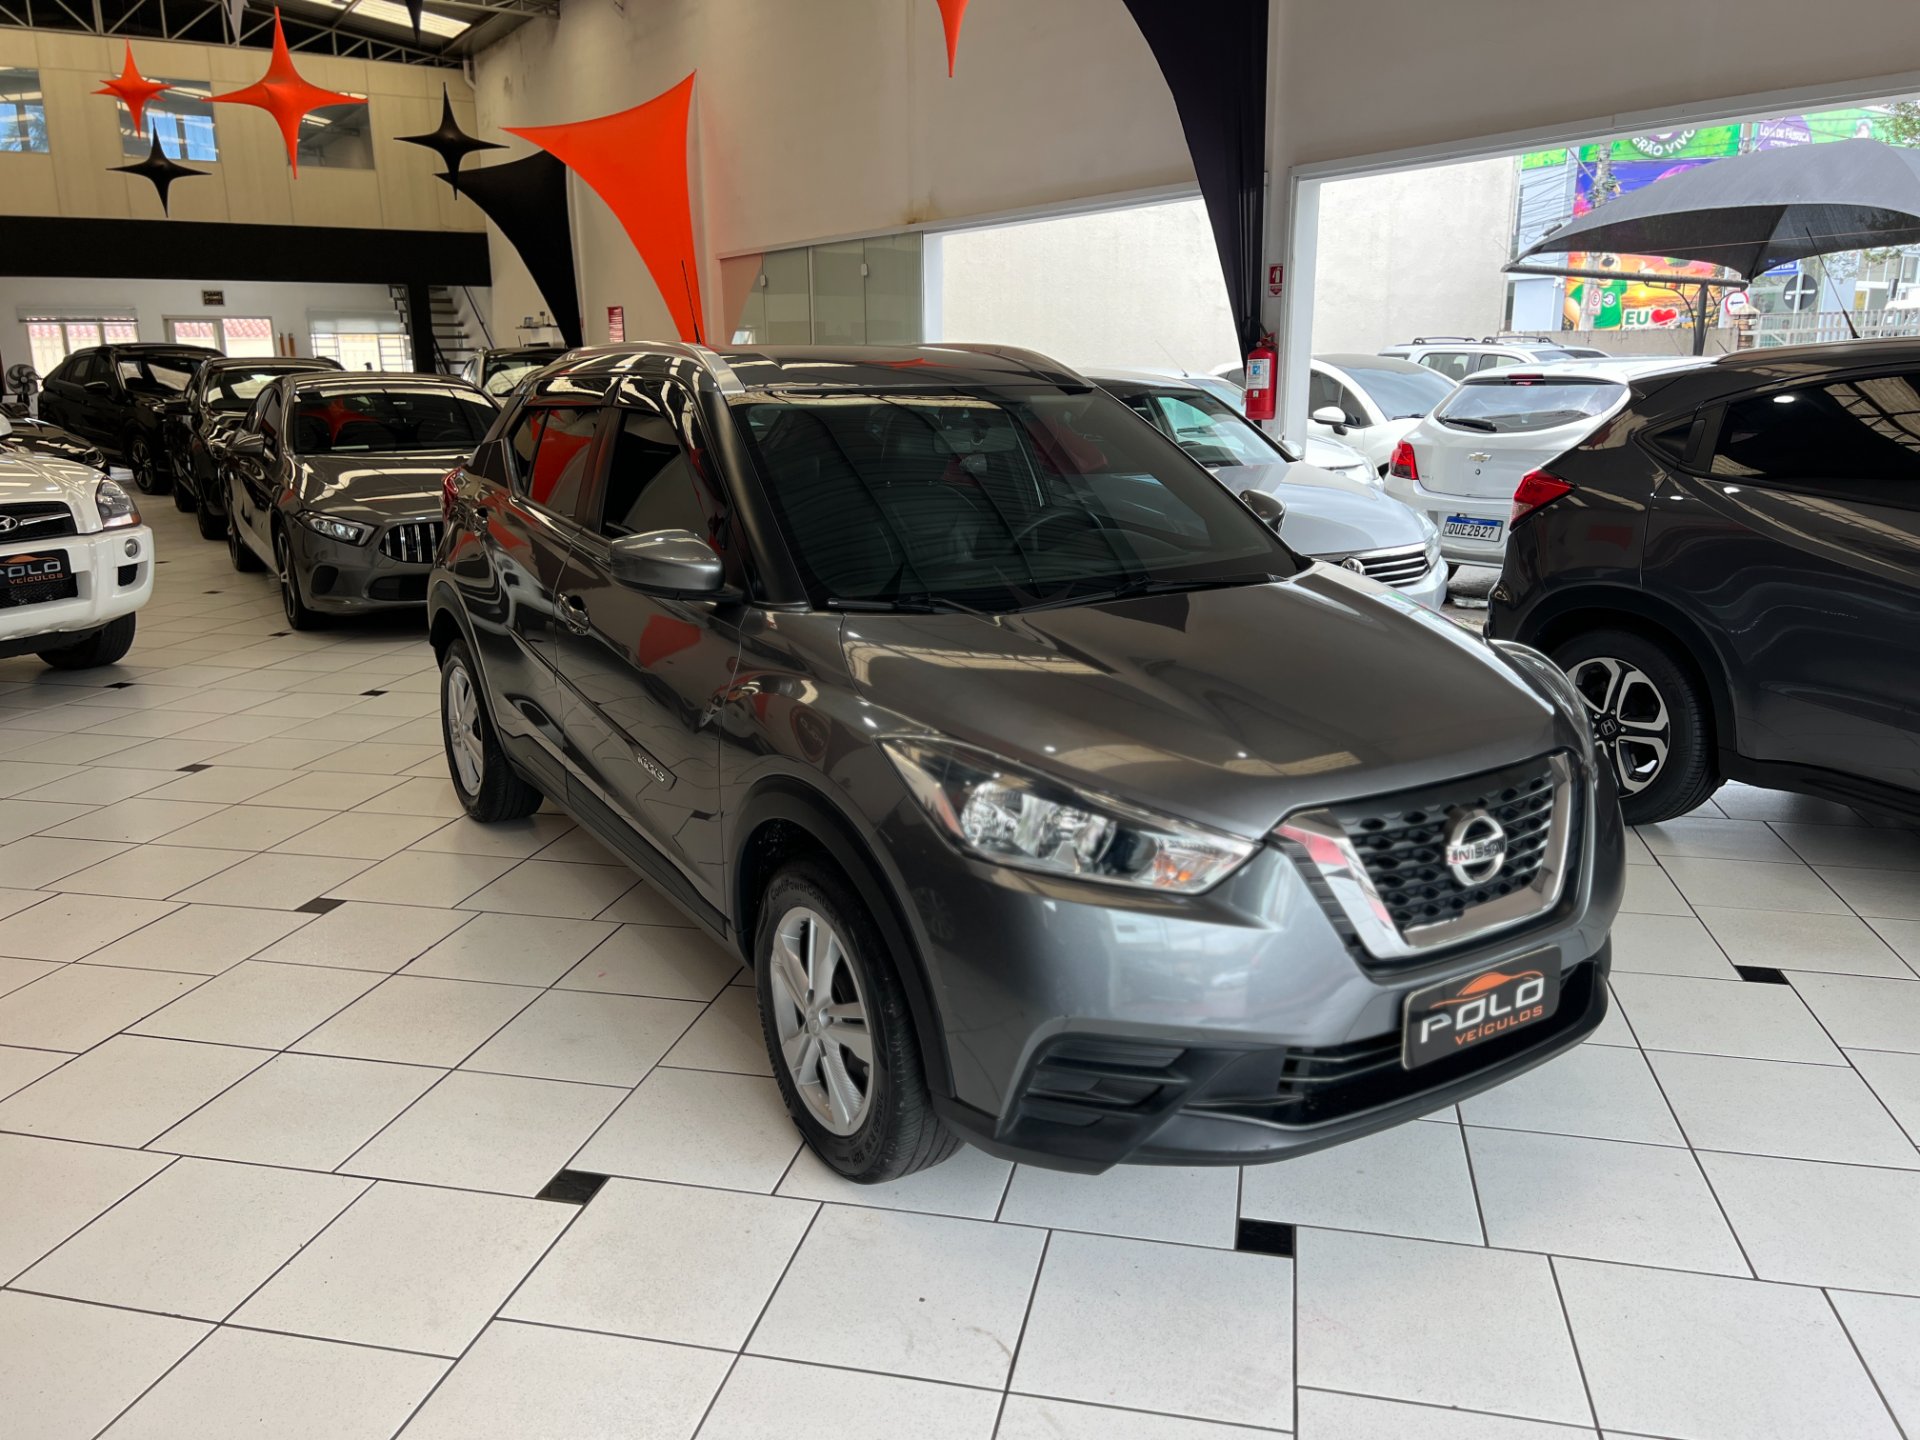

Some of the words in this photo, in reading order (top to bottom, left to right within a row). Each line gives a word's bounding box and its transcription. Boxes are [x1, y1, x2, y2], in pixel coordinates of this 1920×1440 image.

[1624, 310, 1650, 325] EU
[9, 573, 64, 585] VEÍCULOS
[1457, 839, 1504, 861] NISSAN
[1421, 977, 1545, 1044] POLO
[1455, 1005, 1543, 1046] VEÍCULOS
